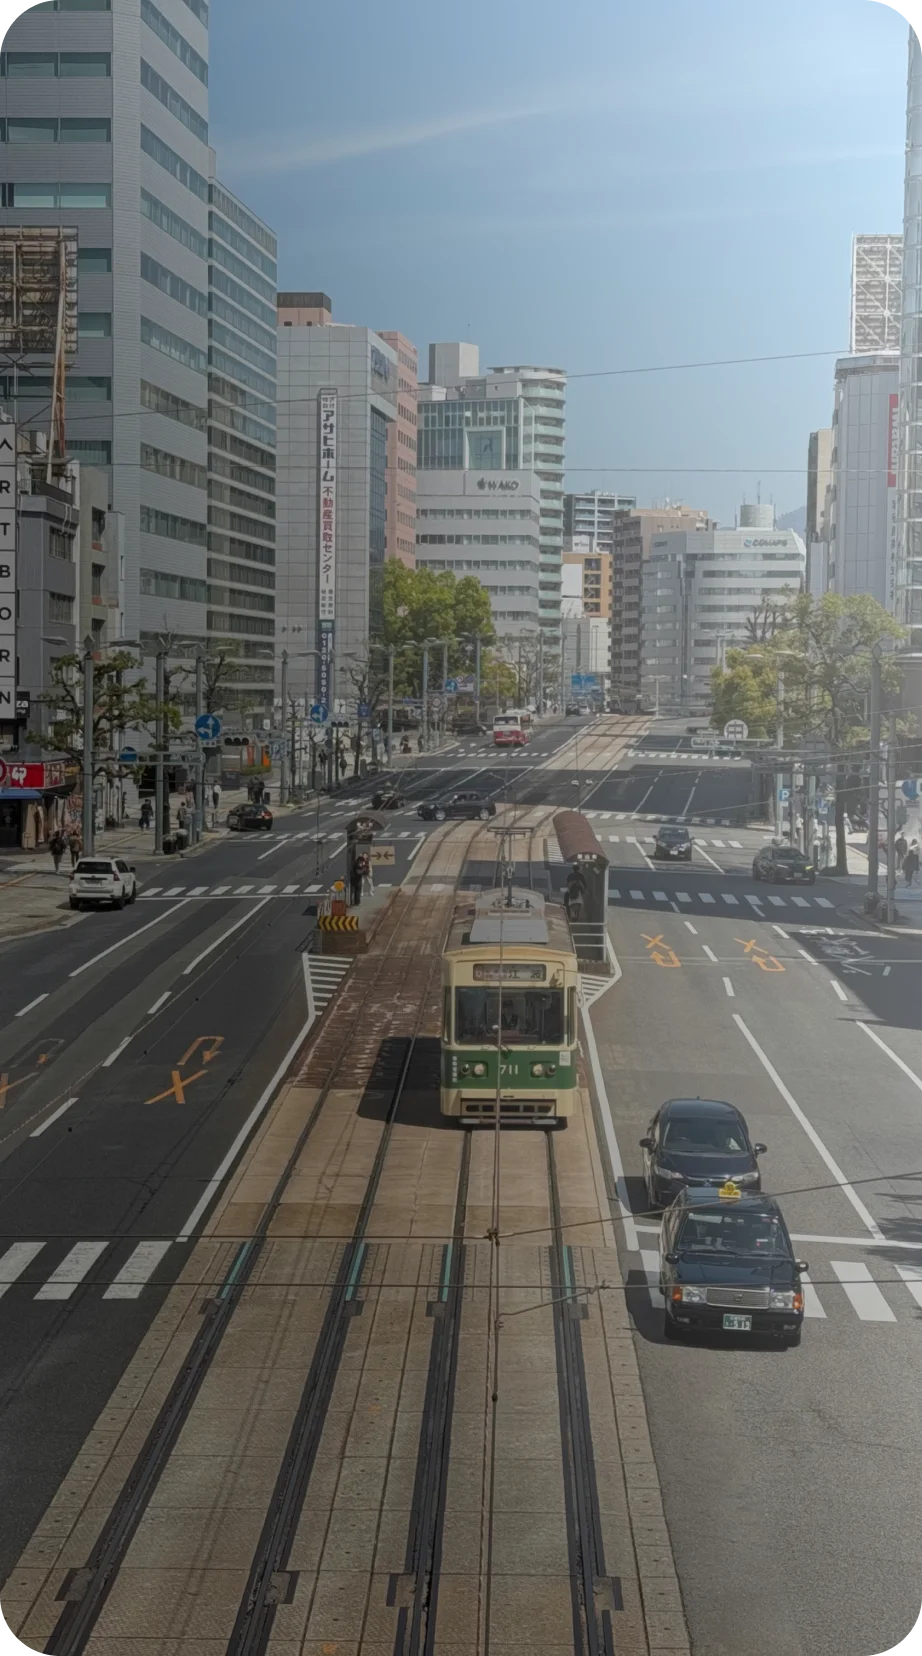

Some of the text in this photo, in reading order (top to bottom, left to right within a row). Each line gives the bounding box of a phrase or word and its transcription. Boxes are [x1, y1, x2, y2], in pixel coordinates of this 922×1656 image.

[322, 409, 335, 482] アサヒホーム
[322, 486, 334, 584] 不動産買取センター
[499, 1064, 519, 1075] 711
